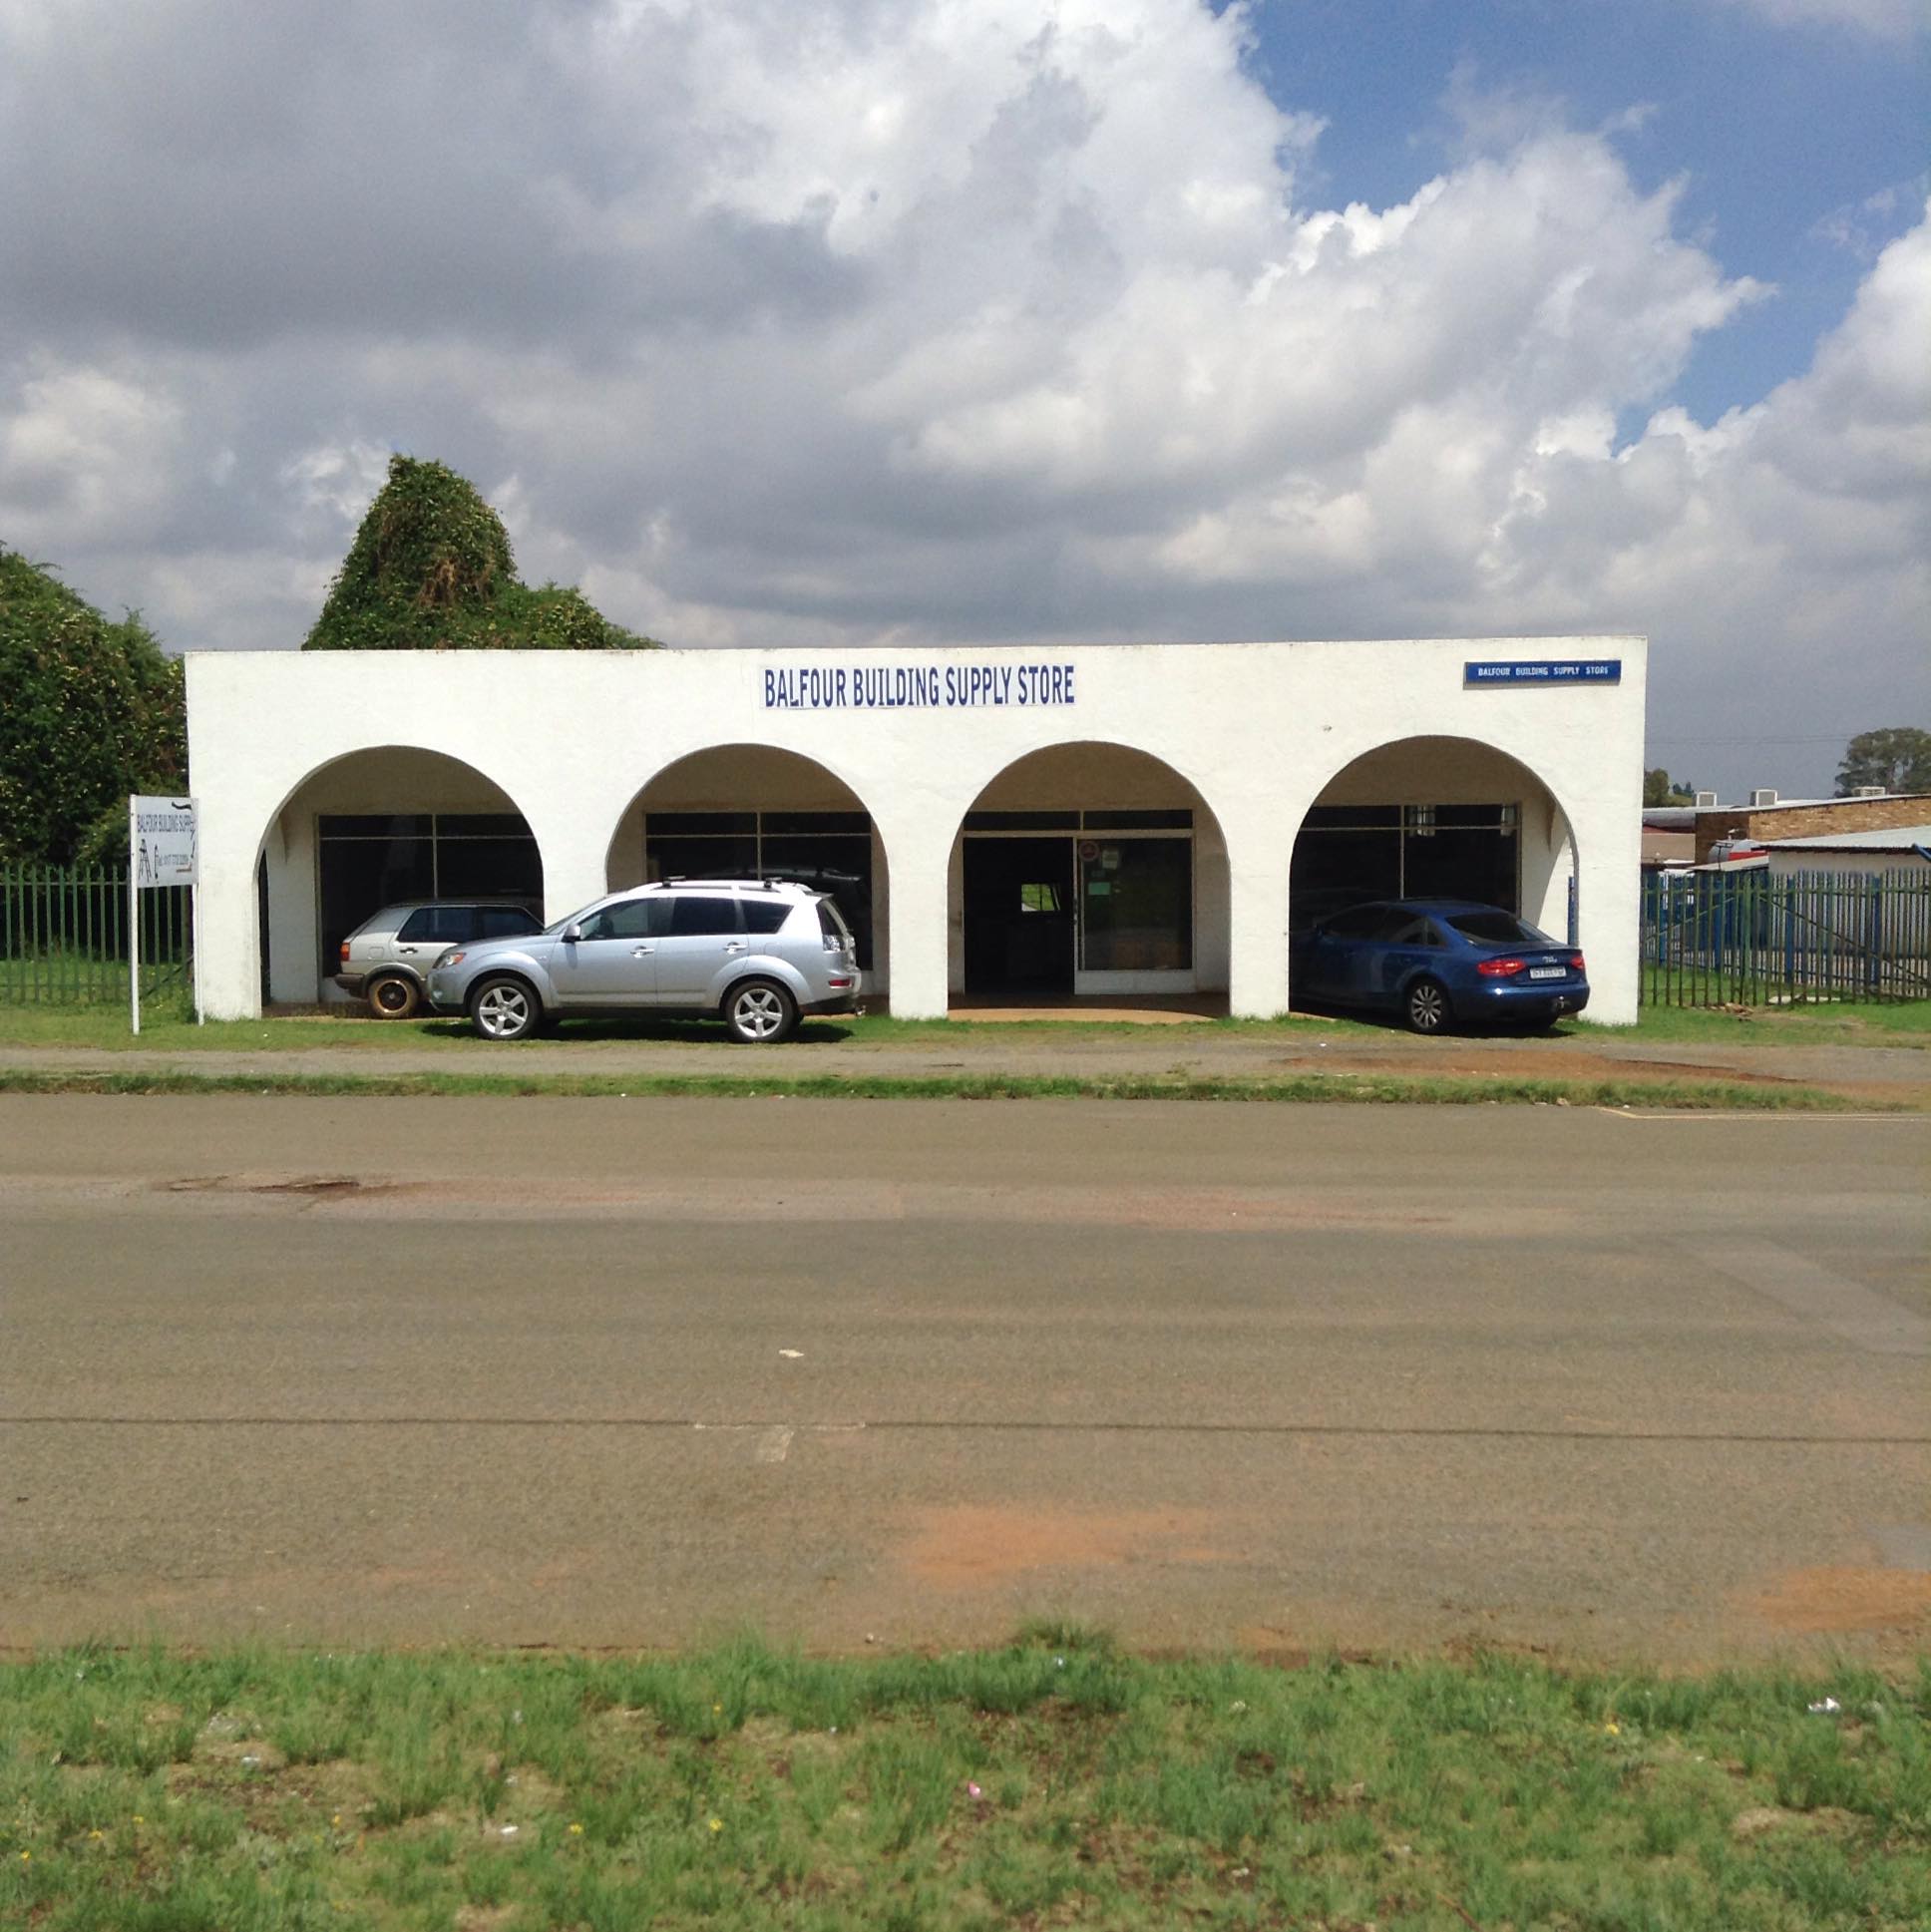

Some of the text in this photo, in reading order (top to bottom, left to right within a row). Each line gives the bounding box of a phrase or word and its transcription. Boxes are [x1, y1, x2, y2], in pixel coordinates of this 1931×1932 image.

[1478, 665, 1609, 676] BALFOUR BUILDING SUPPLY STORE
[765, 664, 1075, 707] BALFOUR BUILDING SUPPLY STORE
